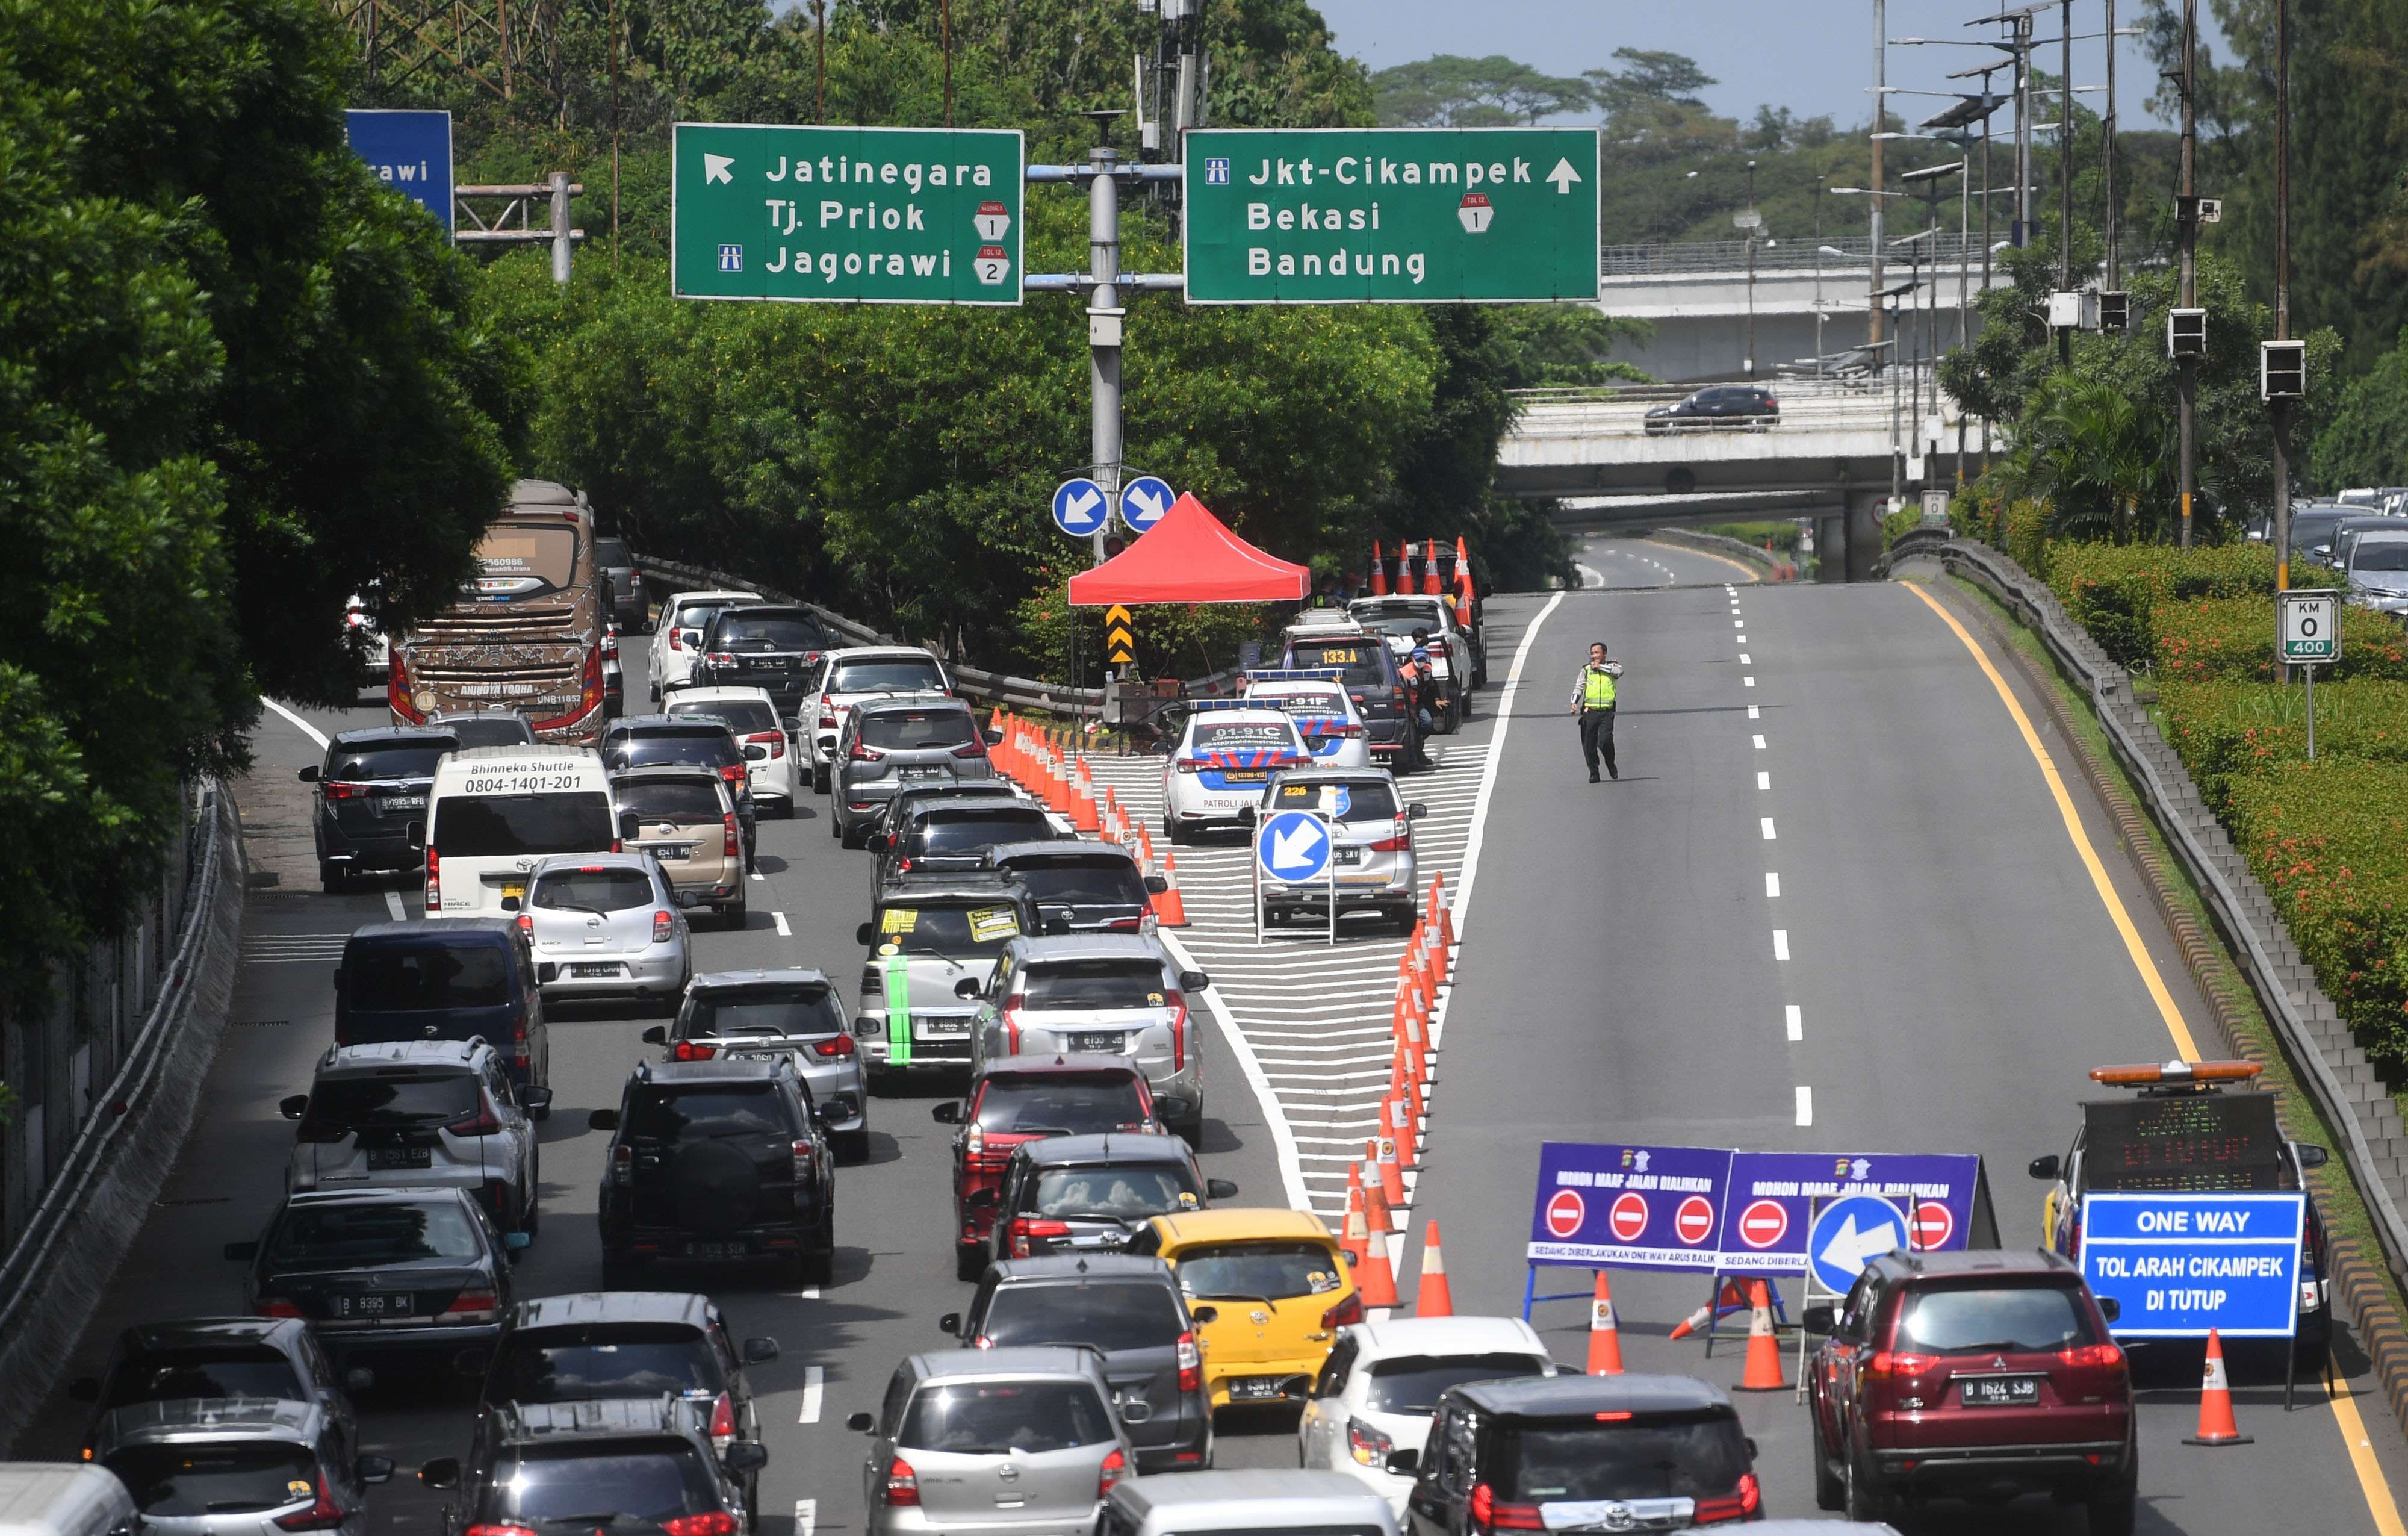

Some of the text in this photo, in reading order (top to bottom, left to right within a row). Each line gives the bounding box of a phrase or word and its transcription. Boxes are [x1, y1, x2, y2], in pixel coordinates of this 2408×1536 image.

[766, 156, 991, 194] Jatinegara
[1249, 157, 1531, 189] Jkt-Cikampek
[766, 199, 925, 235] Tj. Priok
[1248, 202, 1379, 230] Bekasi
[1473, 212, 1478, 228] 1
[990, 220, 995, 236] 1
[766, 247, 950, 284] Jagorawi
[986, 263, 998, 279] 2
[1249, 247, 1424, 284] Bandung
[2298, 603, 2320, 613] KM
[2301, 617, 2318, 637] 0
[2293, 641, 2324, 653] 400
[1323, 650, 1357, 664] 133.A
[1215, 727, 1281, 736] 01-91C
[471, 761, 574, 775] Bhinneka Shuttle
[465, 776, 581, 793] 0804-1401-201
[1284, 786, 1307, 797] 226
[1204, 800, 1238, 808] PATROLI
[1594, 1172, 1624, 1188] MAAF
[1625, 1174, 1659, 1190] JALAN
[1659, 1175, 1713, 1193] DIALIHKAN
[1752, 1181, 1799, 1196] MOHON
[2136, 1211, 2251, 1232] ONE WAY
[1631, 1251, 1648, 1260] ONE
[1649, 1252, 1668, 1261] WAY
[1668, 1253, 1690, 1262] ARUS
[1692, 1254, 1716, 1263] BALIK
[1725, 1256, 1808, 1266] SEDANG DIBERLA
[2096, 1257, 2284, 1277] TOL ARAH CIKAMPEK
[2146, 1290, 2227, 1311] DI TUTUP
[1965, 1380, 2034, 1396] B 1624 SJB
